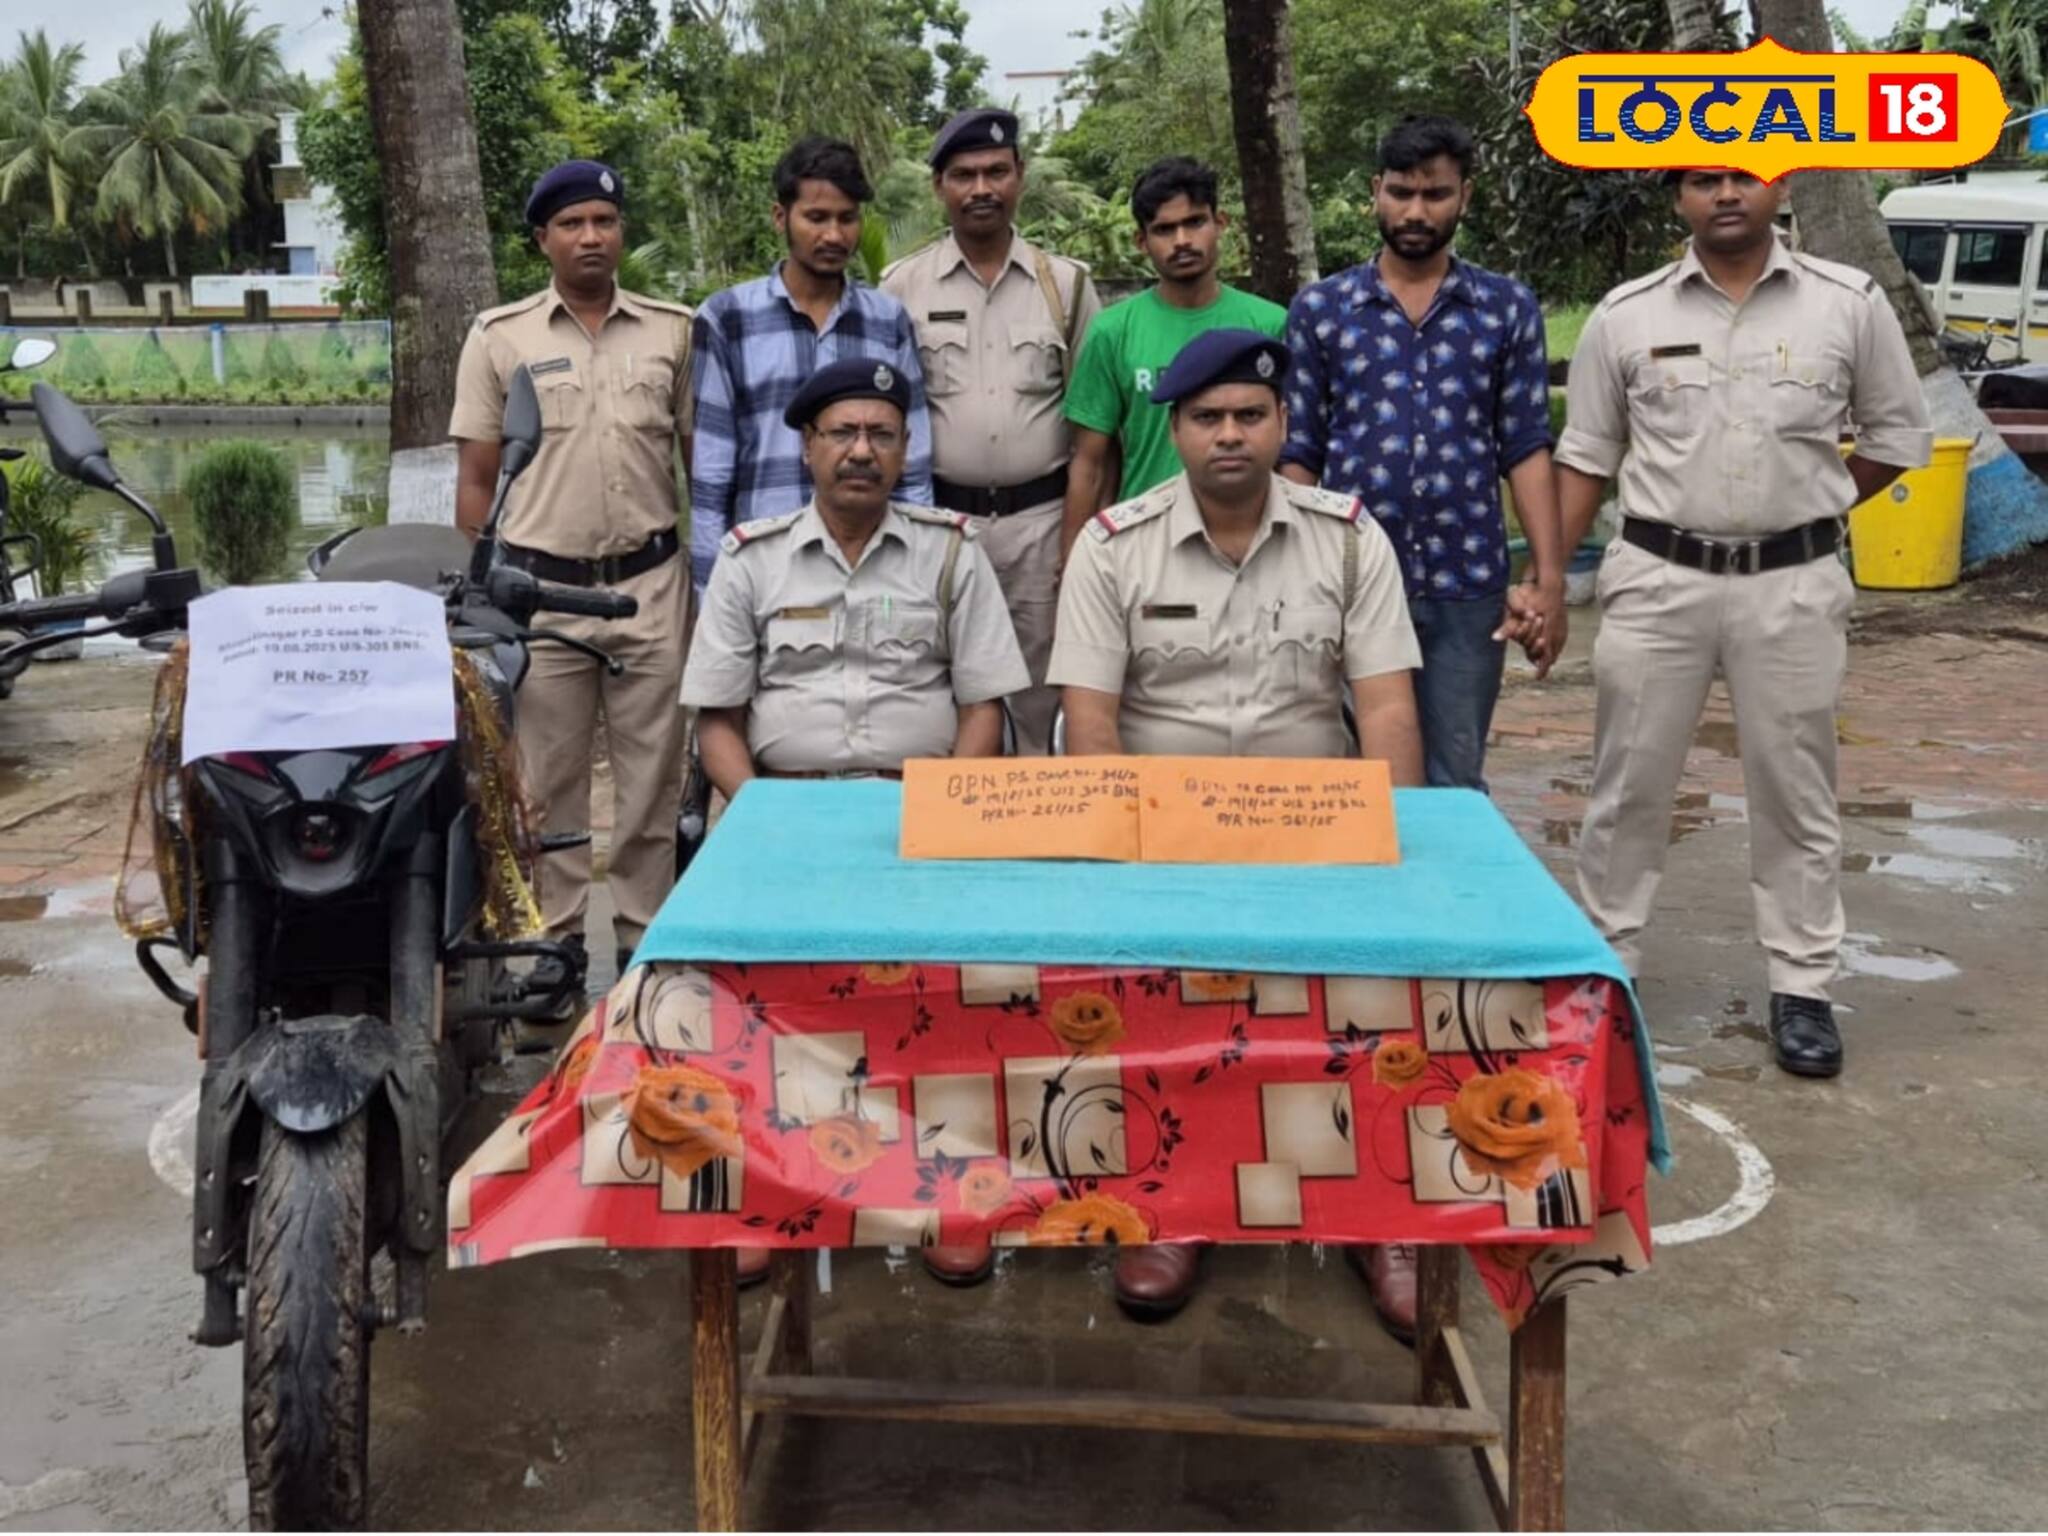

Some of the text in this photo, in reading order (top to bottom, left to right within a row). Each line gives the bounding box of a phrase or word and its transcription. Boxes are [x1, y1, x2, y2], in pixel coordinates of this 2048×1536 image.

[265, 603, 322, 616] Seized
[273, 669, 298, 682] PR
[337, 669, 369, 682] 257
[947, 773, 996, 799] BPN
